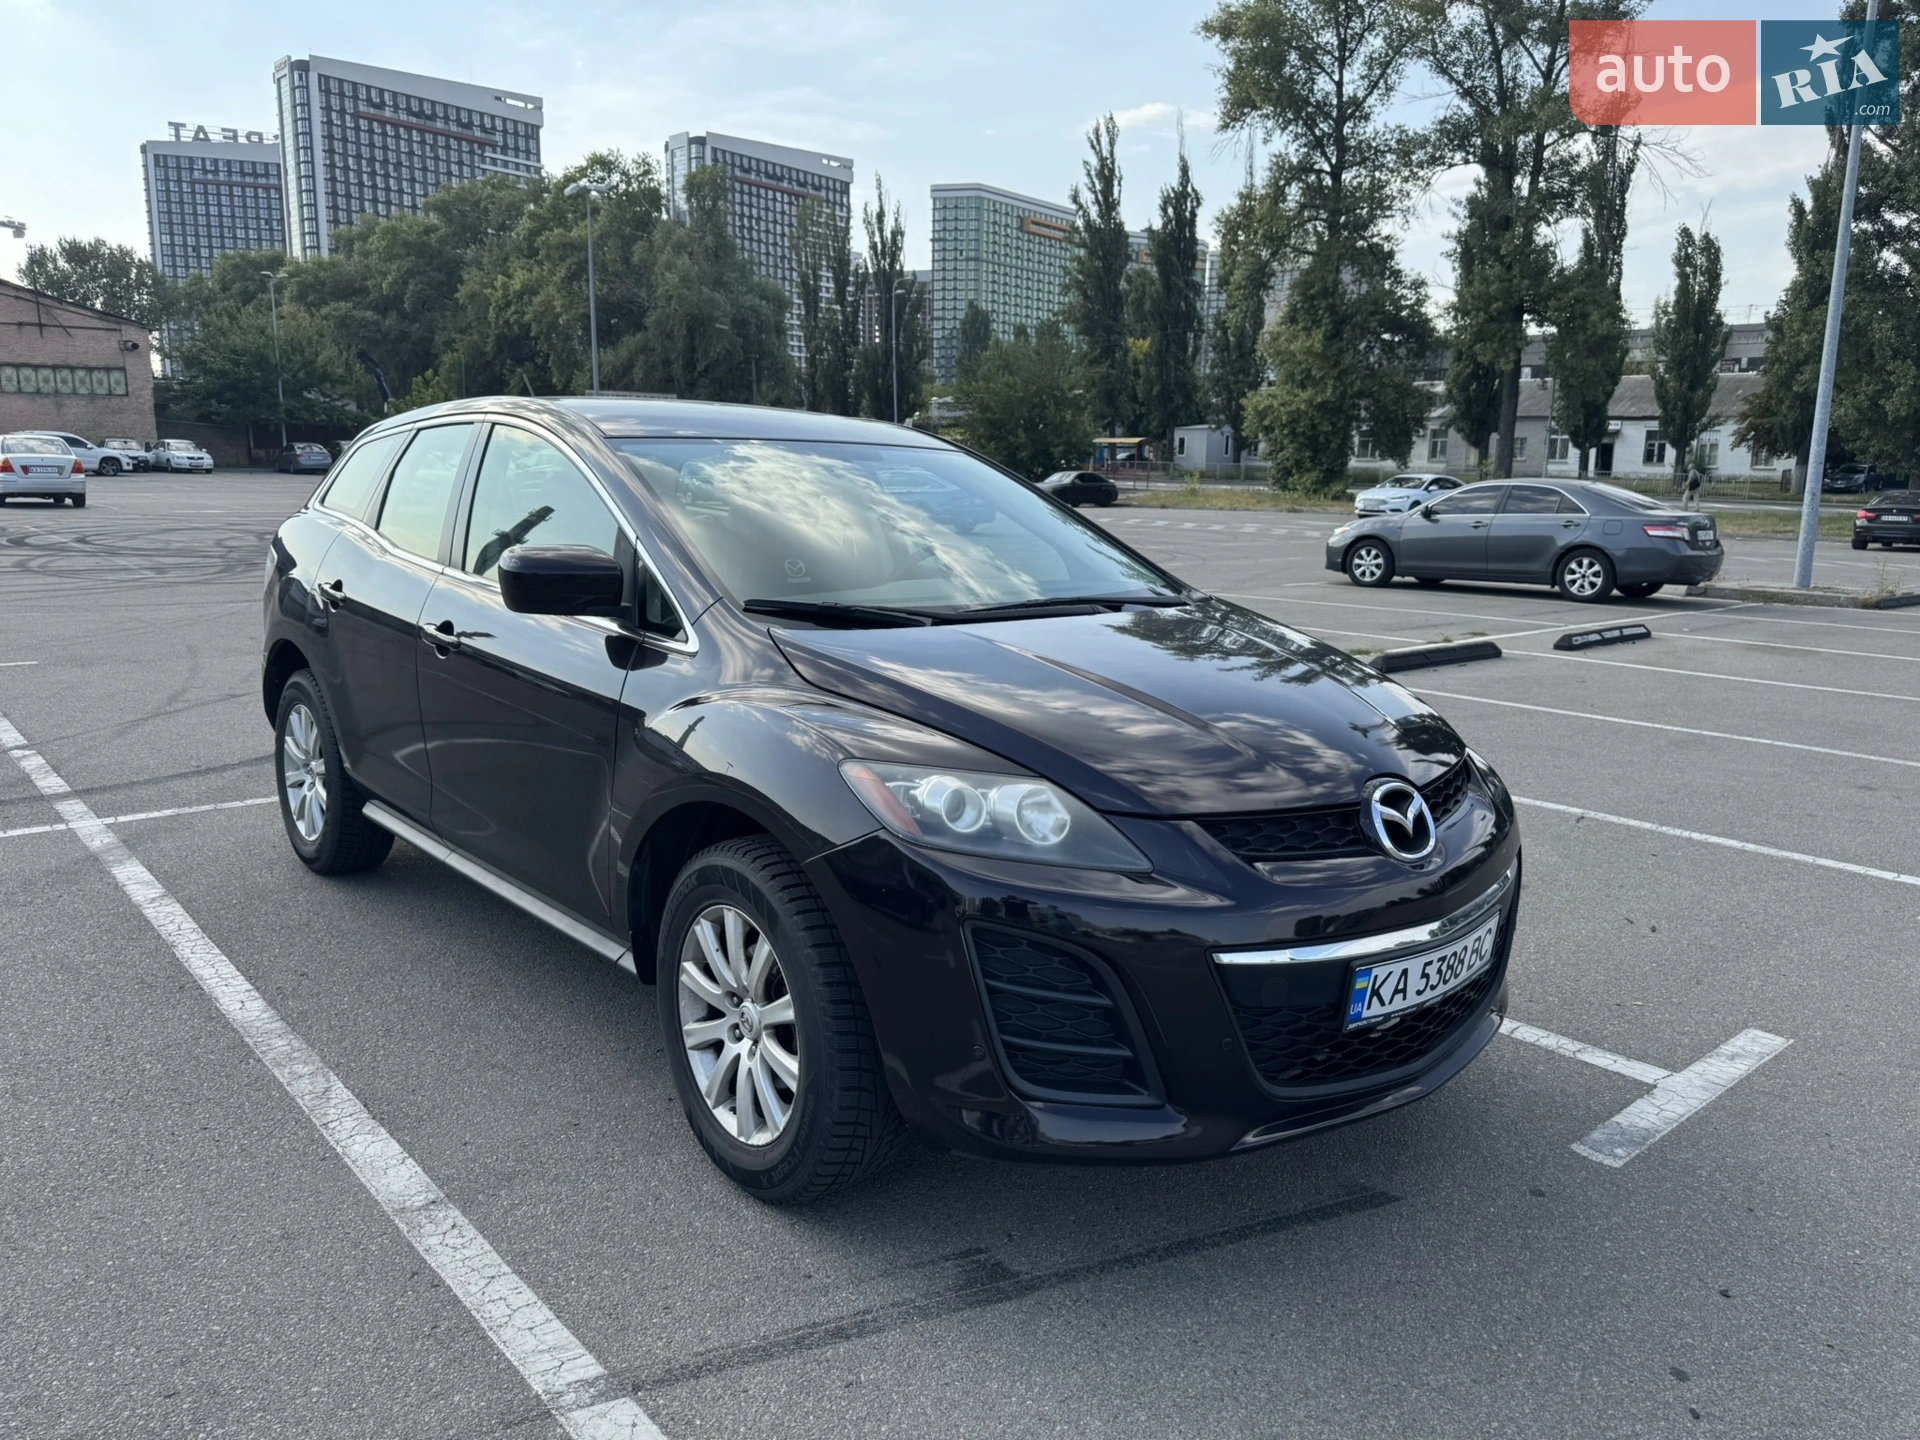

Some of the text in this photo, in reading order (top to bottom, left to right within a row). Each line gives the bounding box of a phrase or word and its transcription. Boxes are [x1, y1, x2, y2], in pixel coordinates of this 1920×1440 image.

[1366, 927, 1493, 1011] KA 5388 BC
[1349, 1002, 1363, 1015] UA
